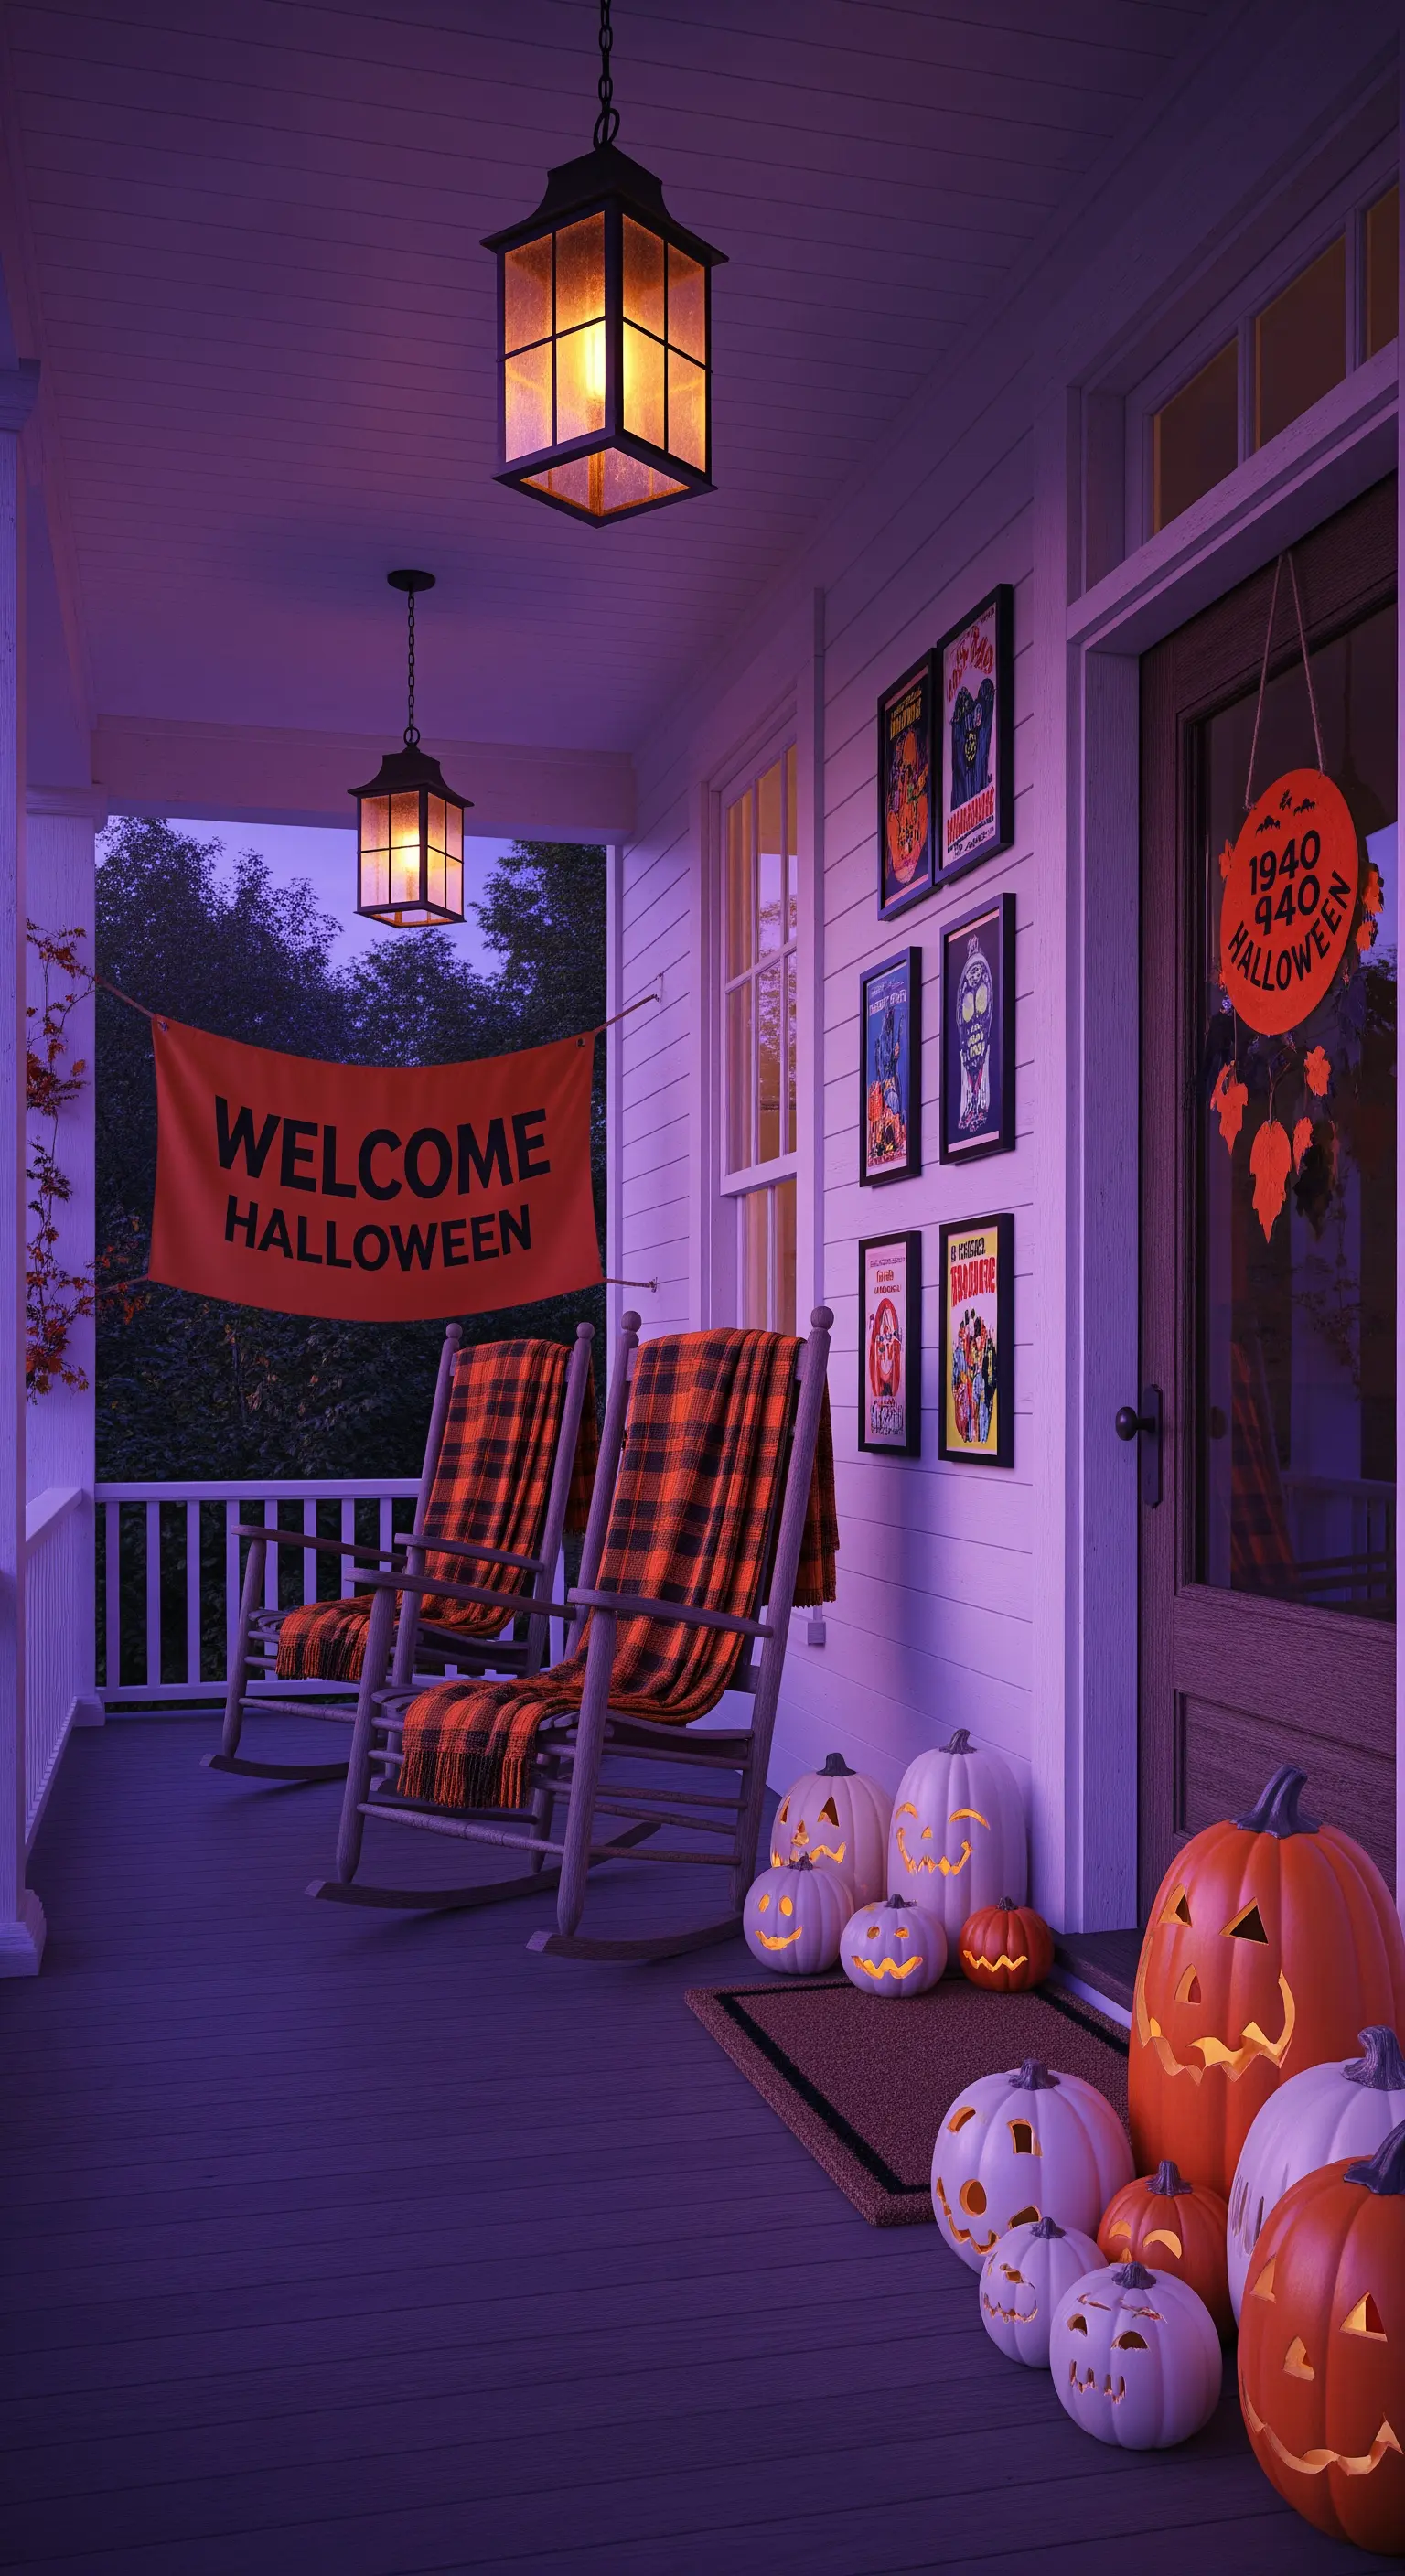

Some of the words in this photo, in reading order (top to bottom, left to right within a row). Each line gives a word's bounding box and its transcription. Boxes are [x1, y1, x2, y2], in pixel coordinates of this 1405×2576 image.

[1249, 830, 1321, 896] 1940
[1228, 870, 1352, 992] HALLOWEEN
[1254, 875, 1321, 936] 940
[215, 1095, 551, 1201] WELCOME
[224, 1194, 532, 1272] HALLOWEEN
